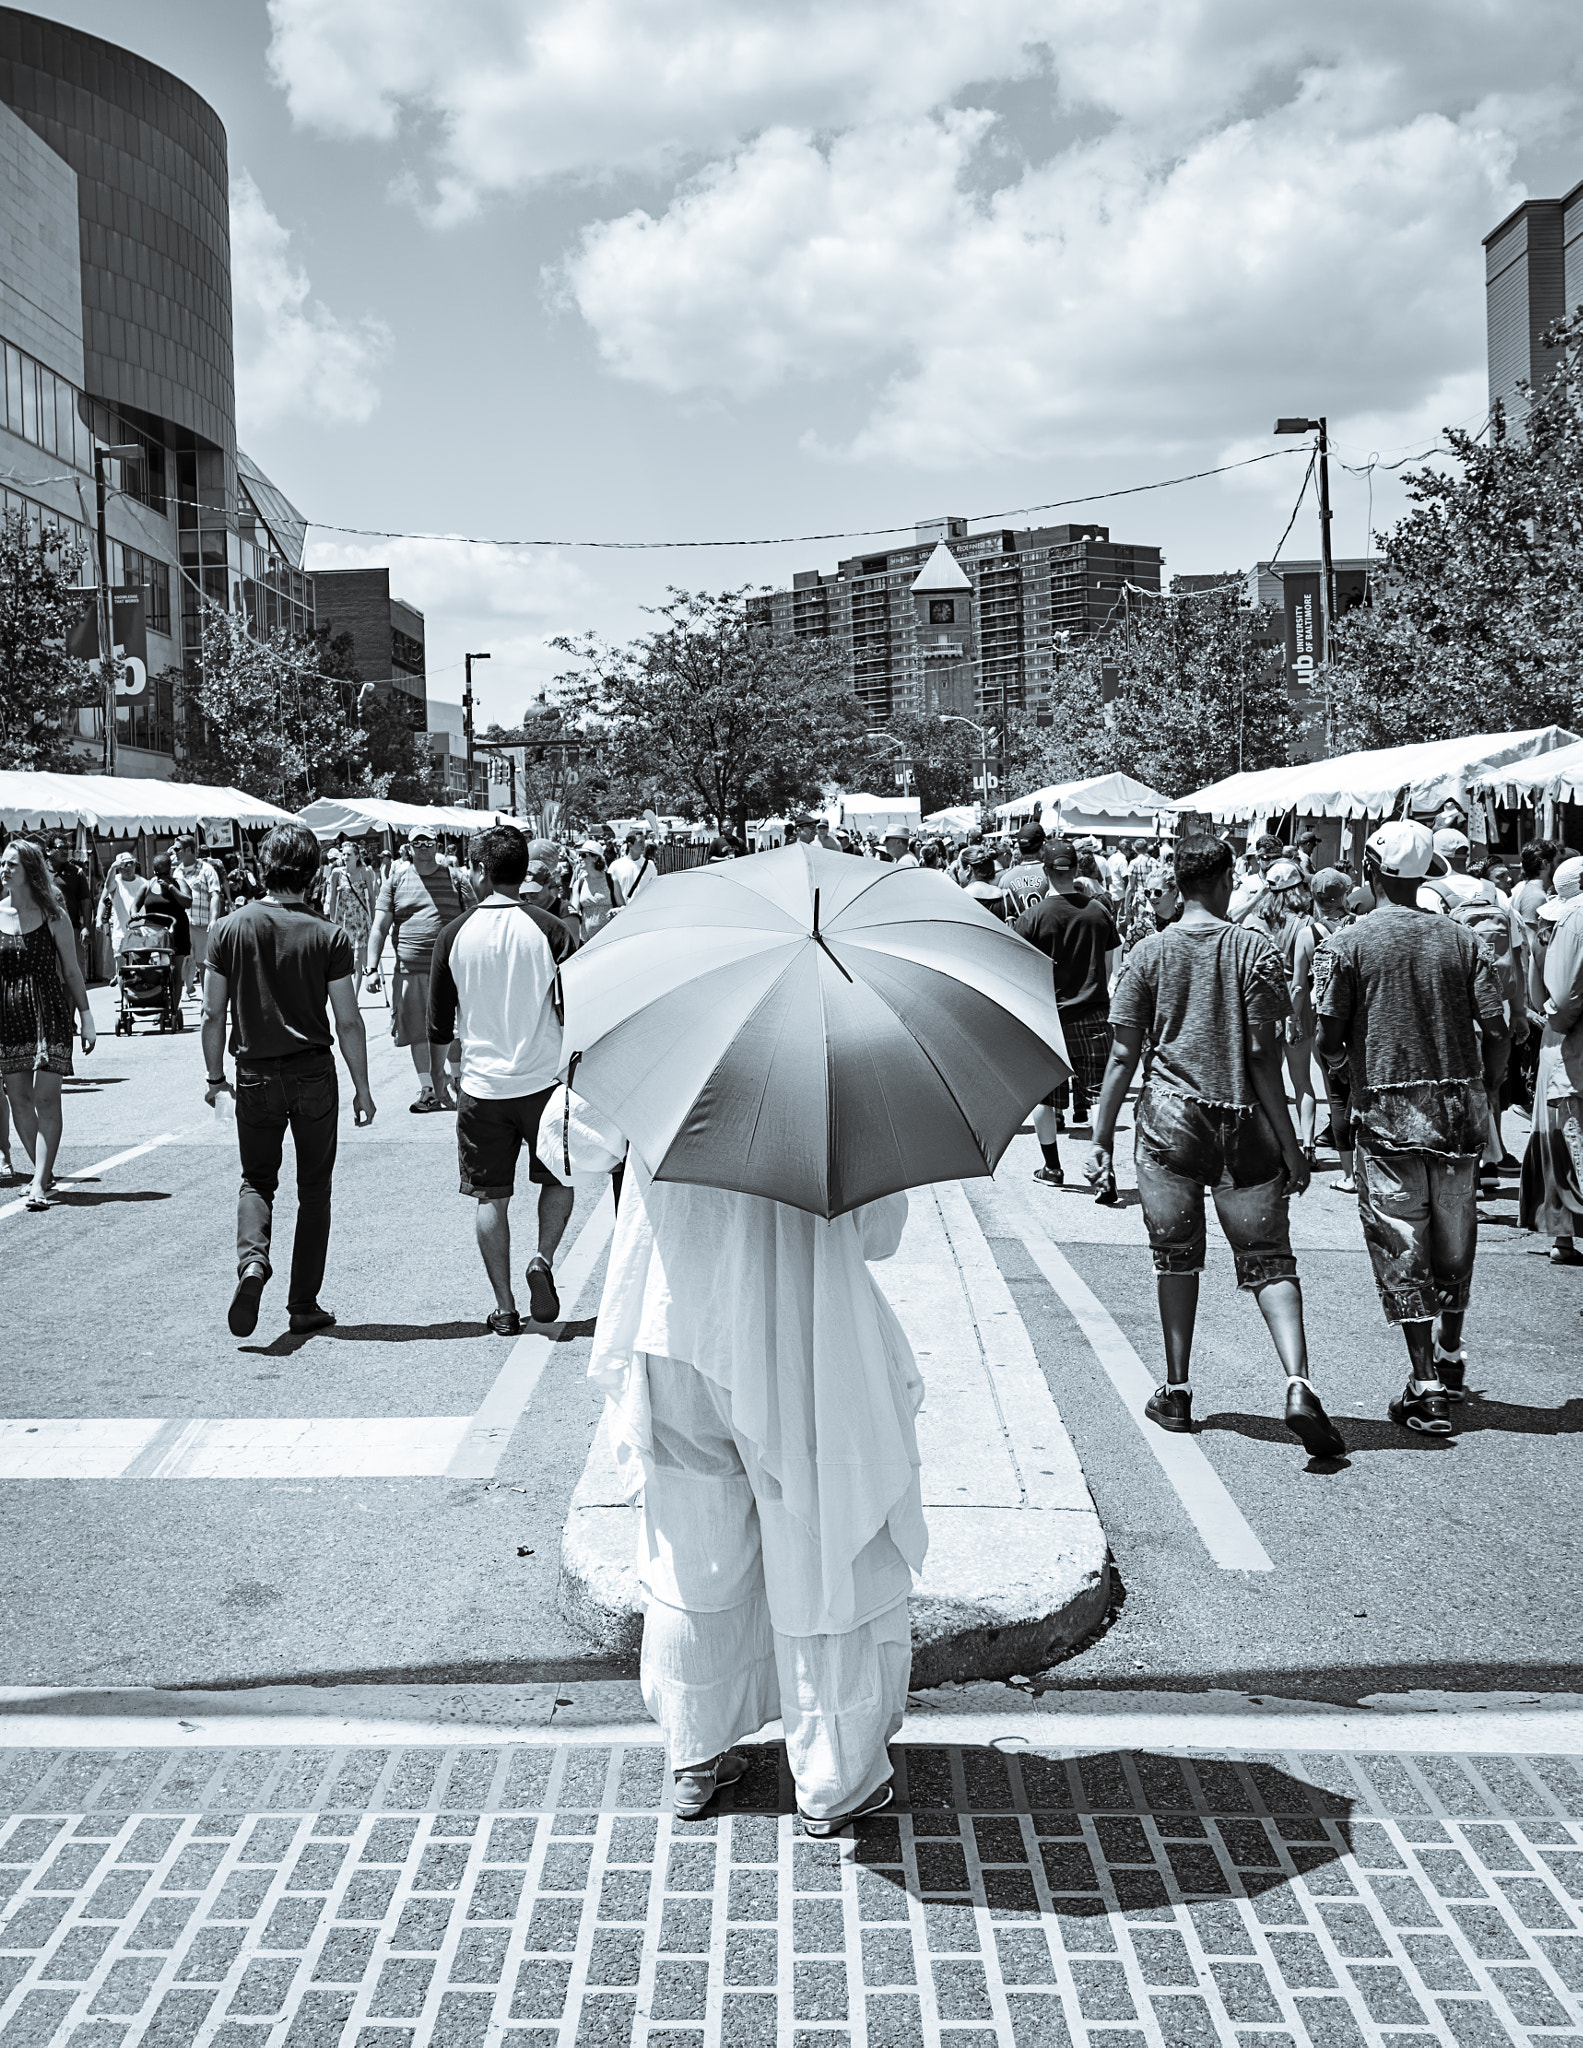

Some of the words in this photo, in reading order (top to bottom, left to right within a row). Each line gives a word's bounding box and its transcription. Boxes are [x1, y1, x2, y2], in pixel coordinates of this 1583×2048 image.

[1295, 605, 1304, 653] UNIVERSITY
[1303, 593, 1313, 641] BALTIMORE
[1305, 642, 1313, 653] OF
[1291, 654, 1315, 684] ub
[972, 771, 999, 789] ub
[1010, 875, 1043, 892] JONES
